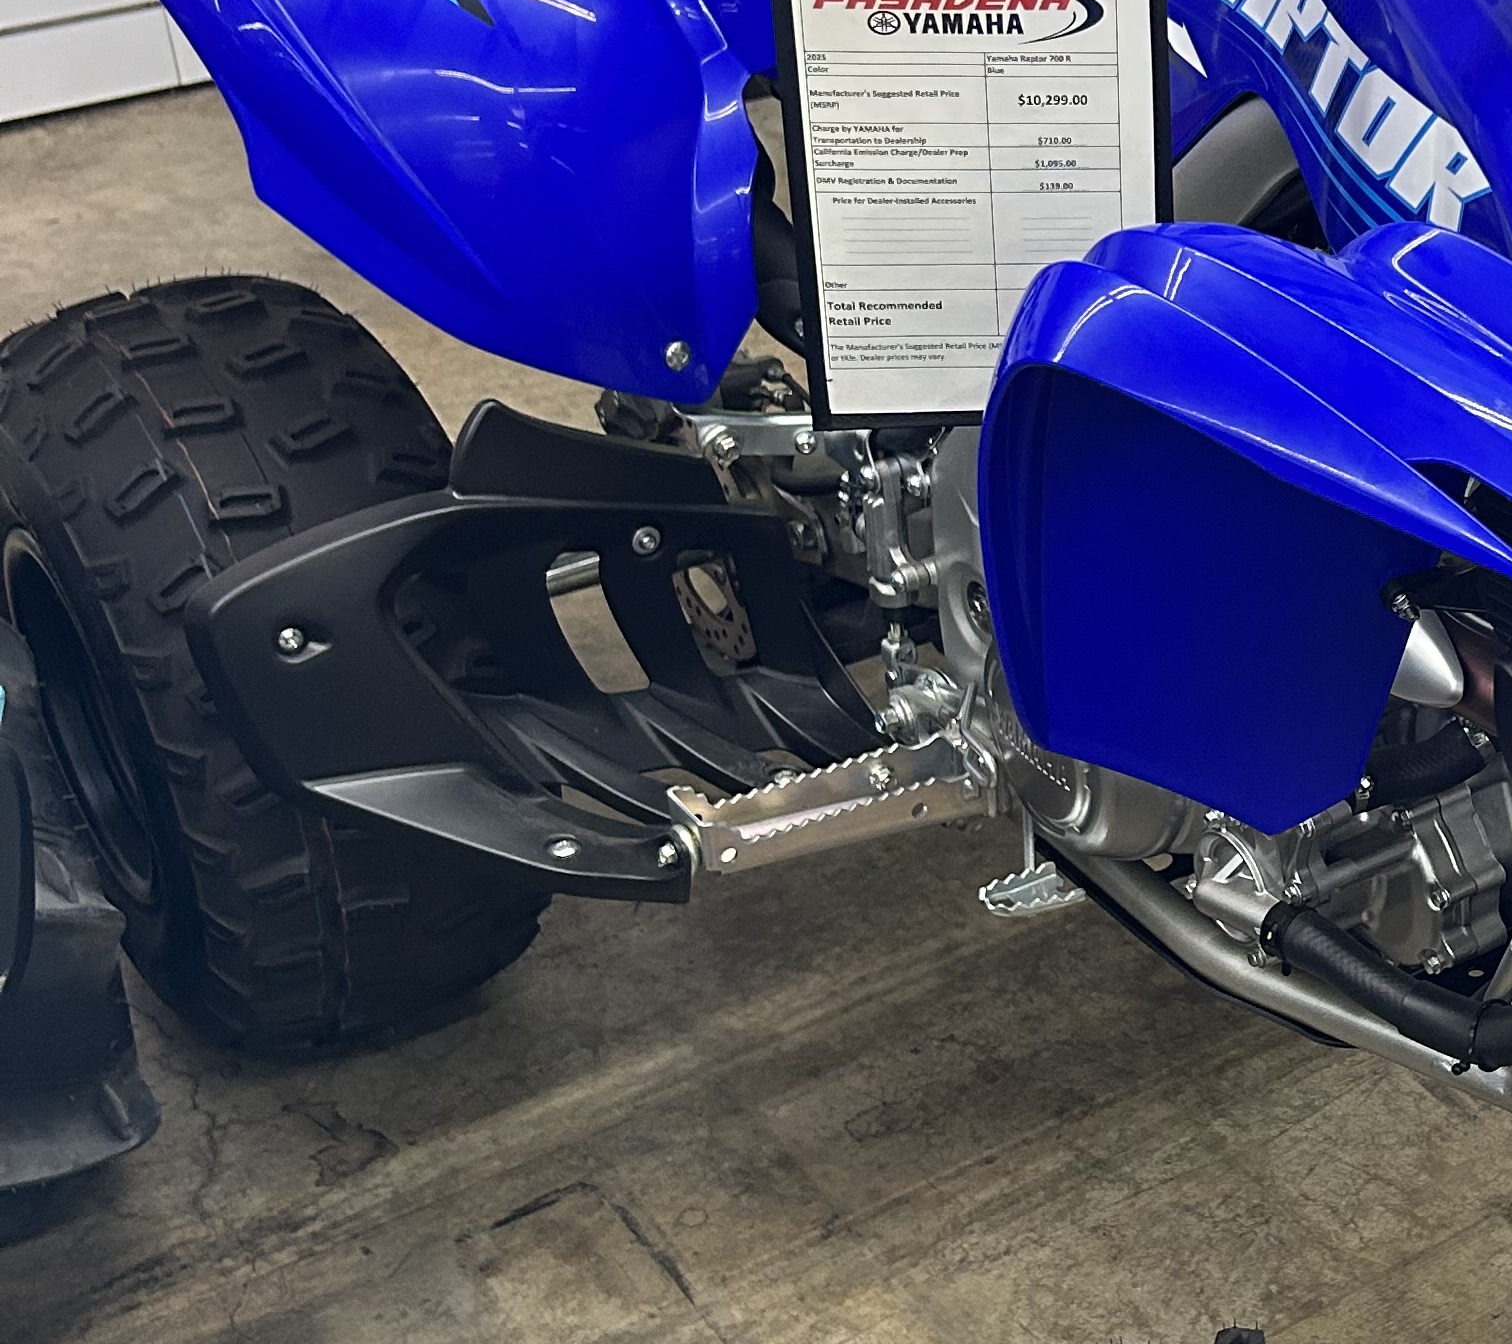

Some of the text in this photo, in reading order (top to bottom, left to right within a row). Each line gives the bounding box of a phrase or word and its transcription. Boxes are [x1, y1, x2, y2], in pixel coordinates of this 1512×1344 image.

[904, 12, 1025, 35] YAMAHA
[987, 55, 1018, 63] Yamaha
[1020, 55, 1047, 64] Raptor
[1049, 54, 1064, 62] 700
[807, 65, 829, 74] Color
[809, 89, 960, 98] Manufacturer's Suggested Retail Price
[1017, 93, 1088, 108] $10,299.00
[810, 101, 840, 110] (MSRP)
[812, 125, 904, 135] Charge by YAMAHA for
[813, 136, 927, 146] Transportation to Dealership
[1037, 136, 1072, 145] $710.00
[814, 148, 852, 156] California
[853, 148, 889, 156] Emission
[949, 149, 969, 158] Prep
[814, 160, 855, 169] Surcharge
[837, 177, 886, 186] Registration
[887, 177, 895, 185] &
[896, 177, 958, 185] Documentation
[832, 197, 852, 205] Price
[853, 197, 866, 205] for
[931, 197, 977, 205] Accessories
[824, 281, 848, 289] Other
[827, 301, 943, 311] Total Recommended
[828, 317, 892, 326] Retail Price
[830, 343, 844, 351] The
[845, 342, 904, 351] Manufacturer's
[905, 342, 943, 352] Suggested
[860, 354, 885, 362] Dealer
[886, 354, 909, 363] prices
[911, 354, 926, 362] may
